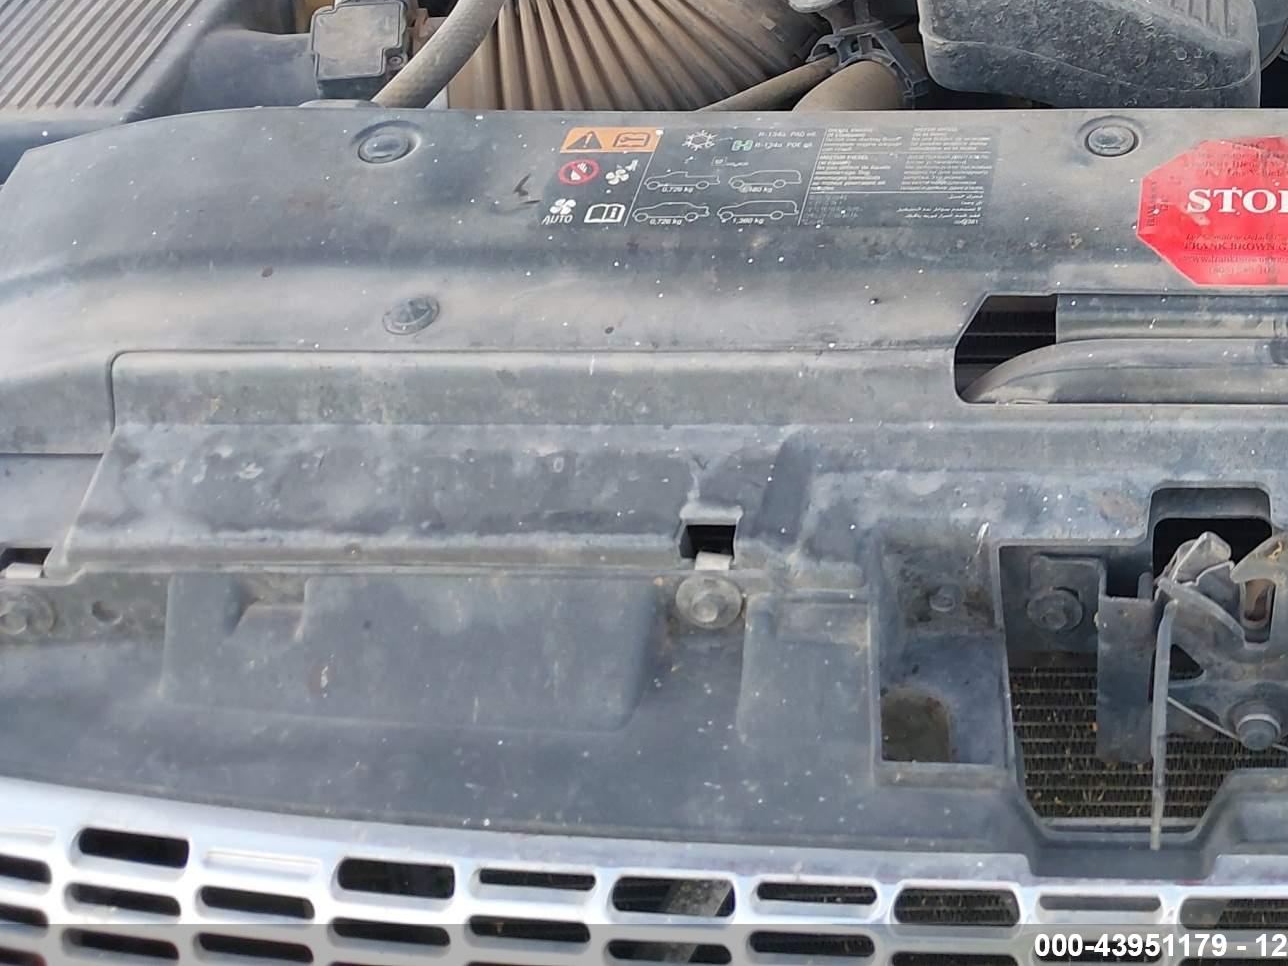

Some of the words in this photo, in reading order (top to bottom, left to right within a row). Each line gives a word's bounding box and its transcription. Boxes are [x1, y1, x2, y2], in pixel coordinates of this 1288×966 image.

[541, 214, 574, 226] AUTO
[1184, 242, 1228, 250] FRANK
[1230, 242, 1275, 251] BROWN
